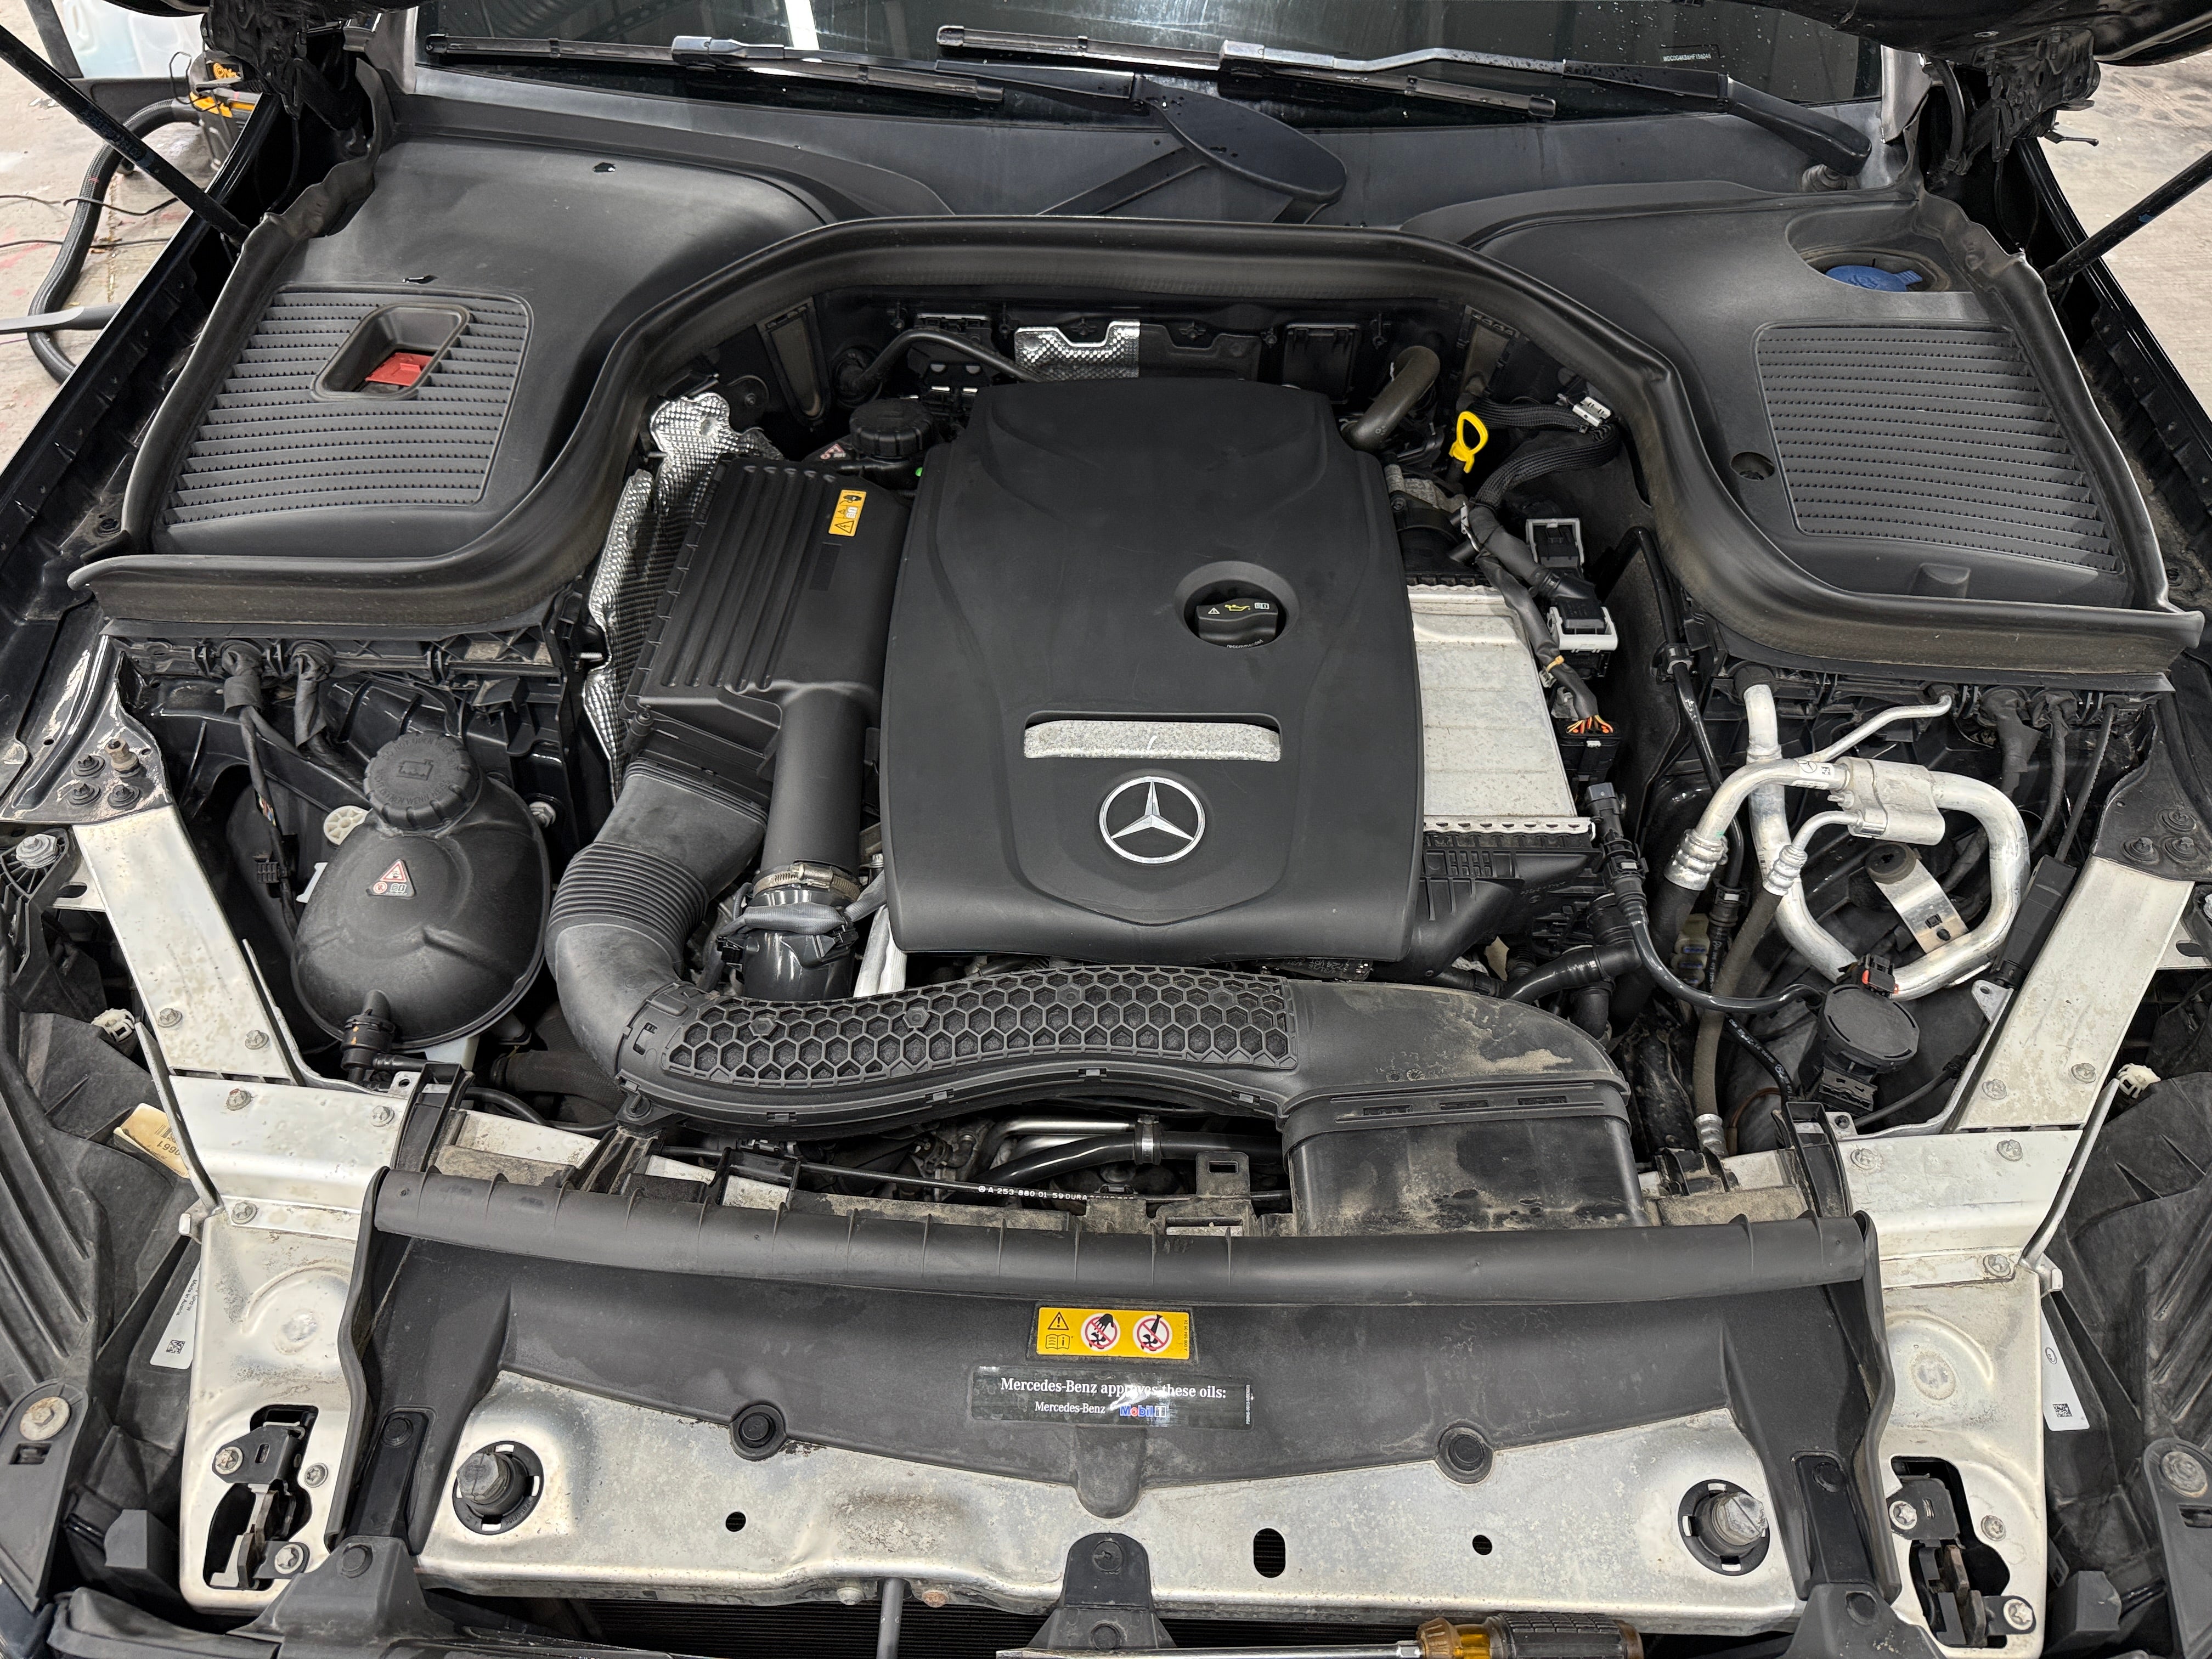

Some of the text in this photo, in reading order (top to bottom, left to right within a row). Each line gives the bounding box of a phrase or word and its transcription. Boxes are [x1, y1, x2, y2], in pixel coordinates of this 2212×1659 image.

[1226, 639, 1264, 649] recommended
[1000, 1378, 1227, 1398] Mercedes-Benz approves these oils:
[1035, 1401, 1106, 1414] Mercedes-Benz
[1119, 1404, 1153, 1417] Mobil
